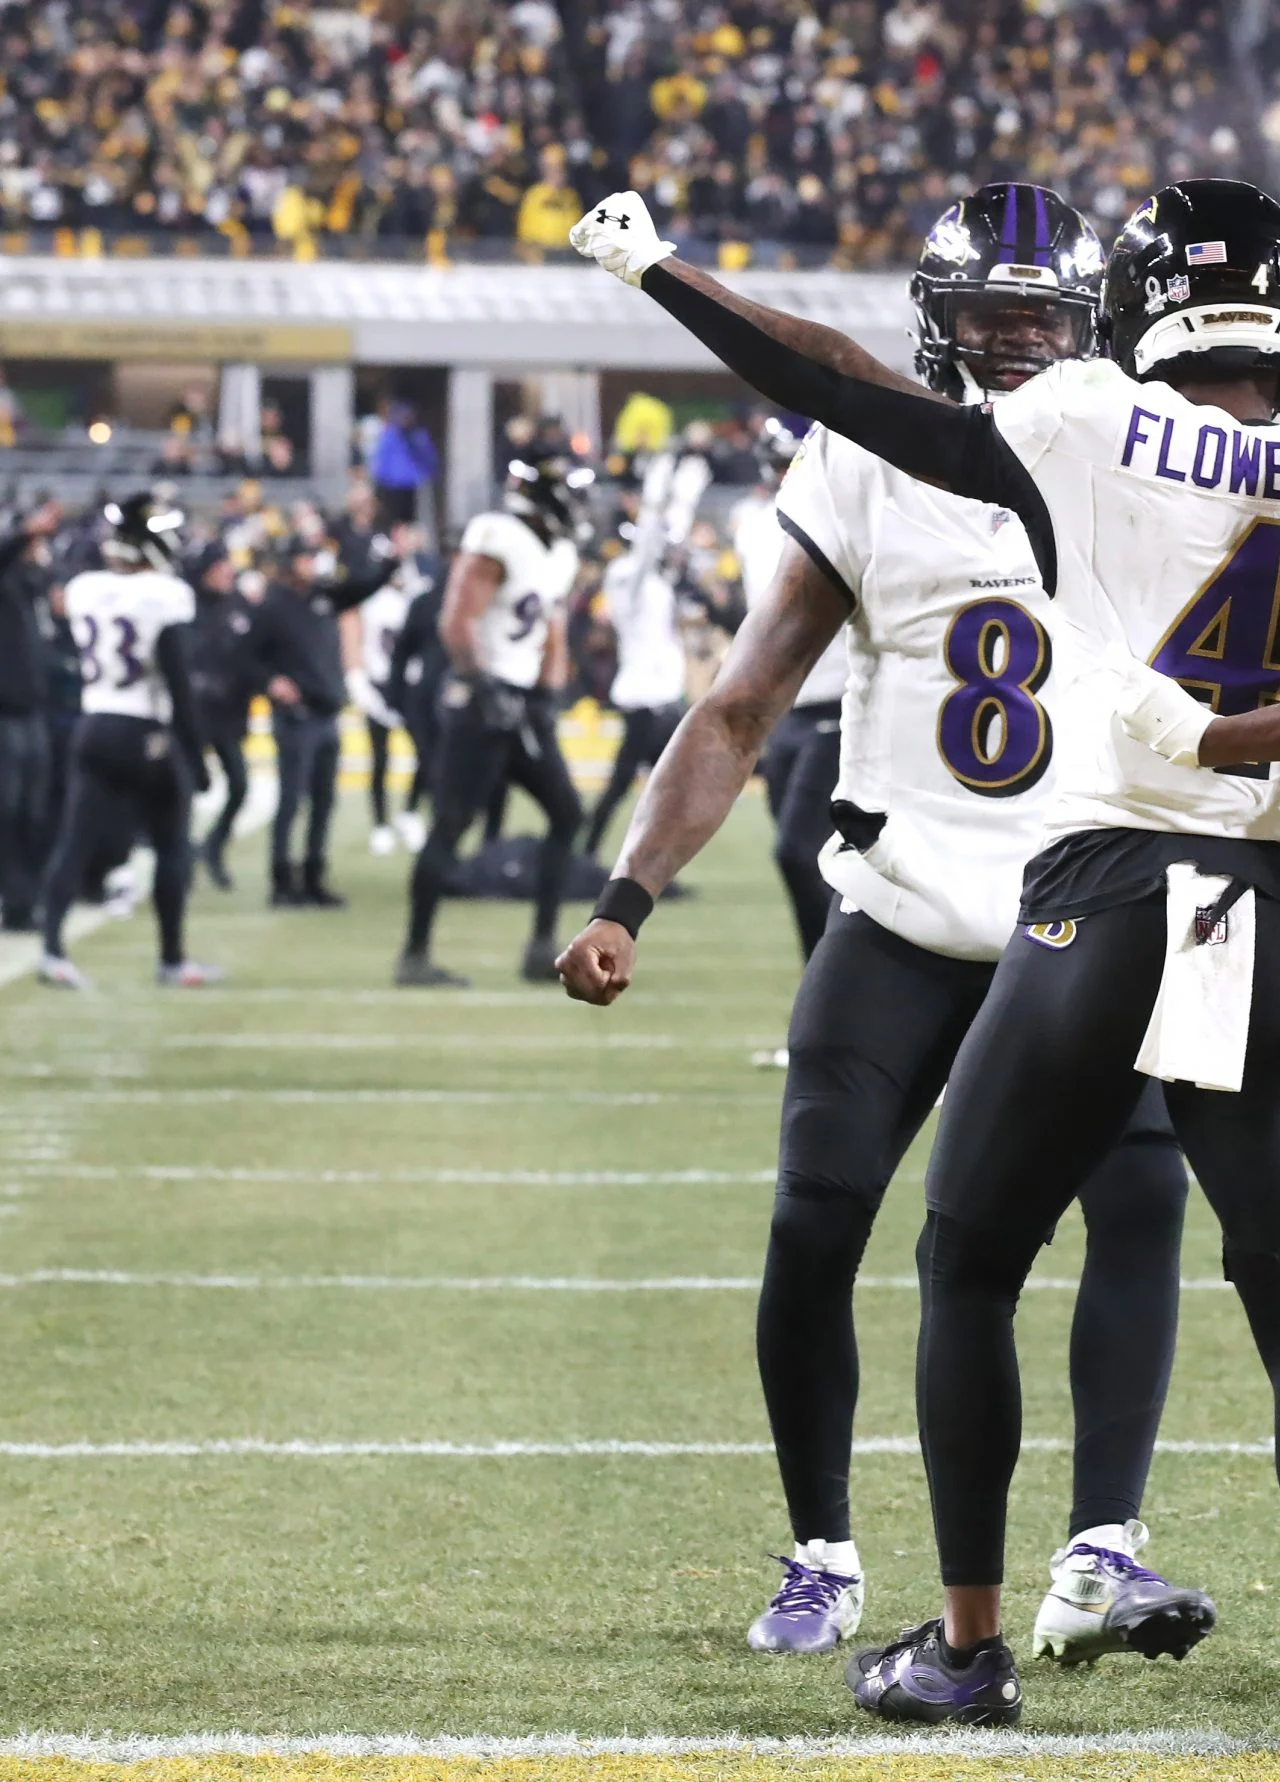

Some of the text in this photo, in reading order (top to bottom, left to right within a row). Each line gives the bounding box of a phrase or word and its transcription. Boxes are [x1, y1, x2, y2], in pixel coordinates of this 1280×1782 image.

[1251, 263, 1269, 295] 4
[1201, 311, 1273, 326] RAVENS
[969, 577, 1036, 588] RAVENS
[936, 596, 1053, 798] 8
